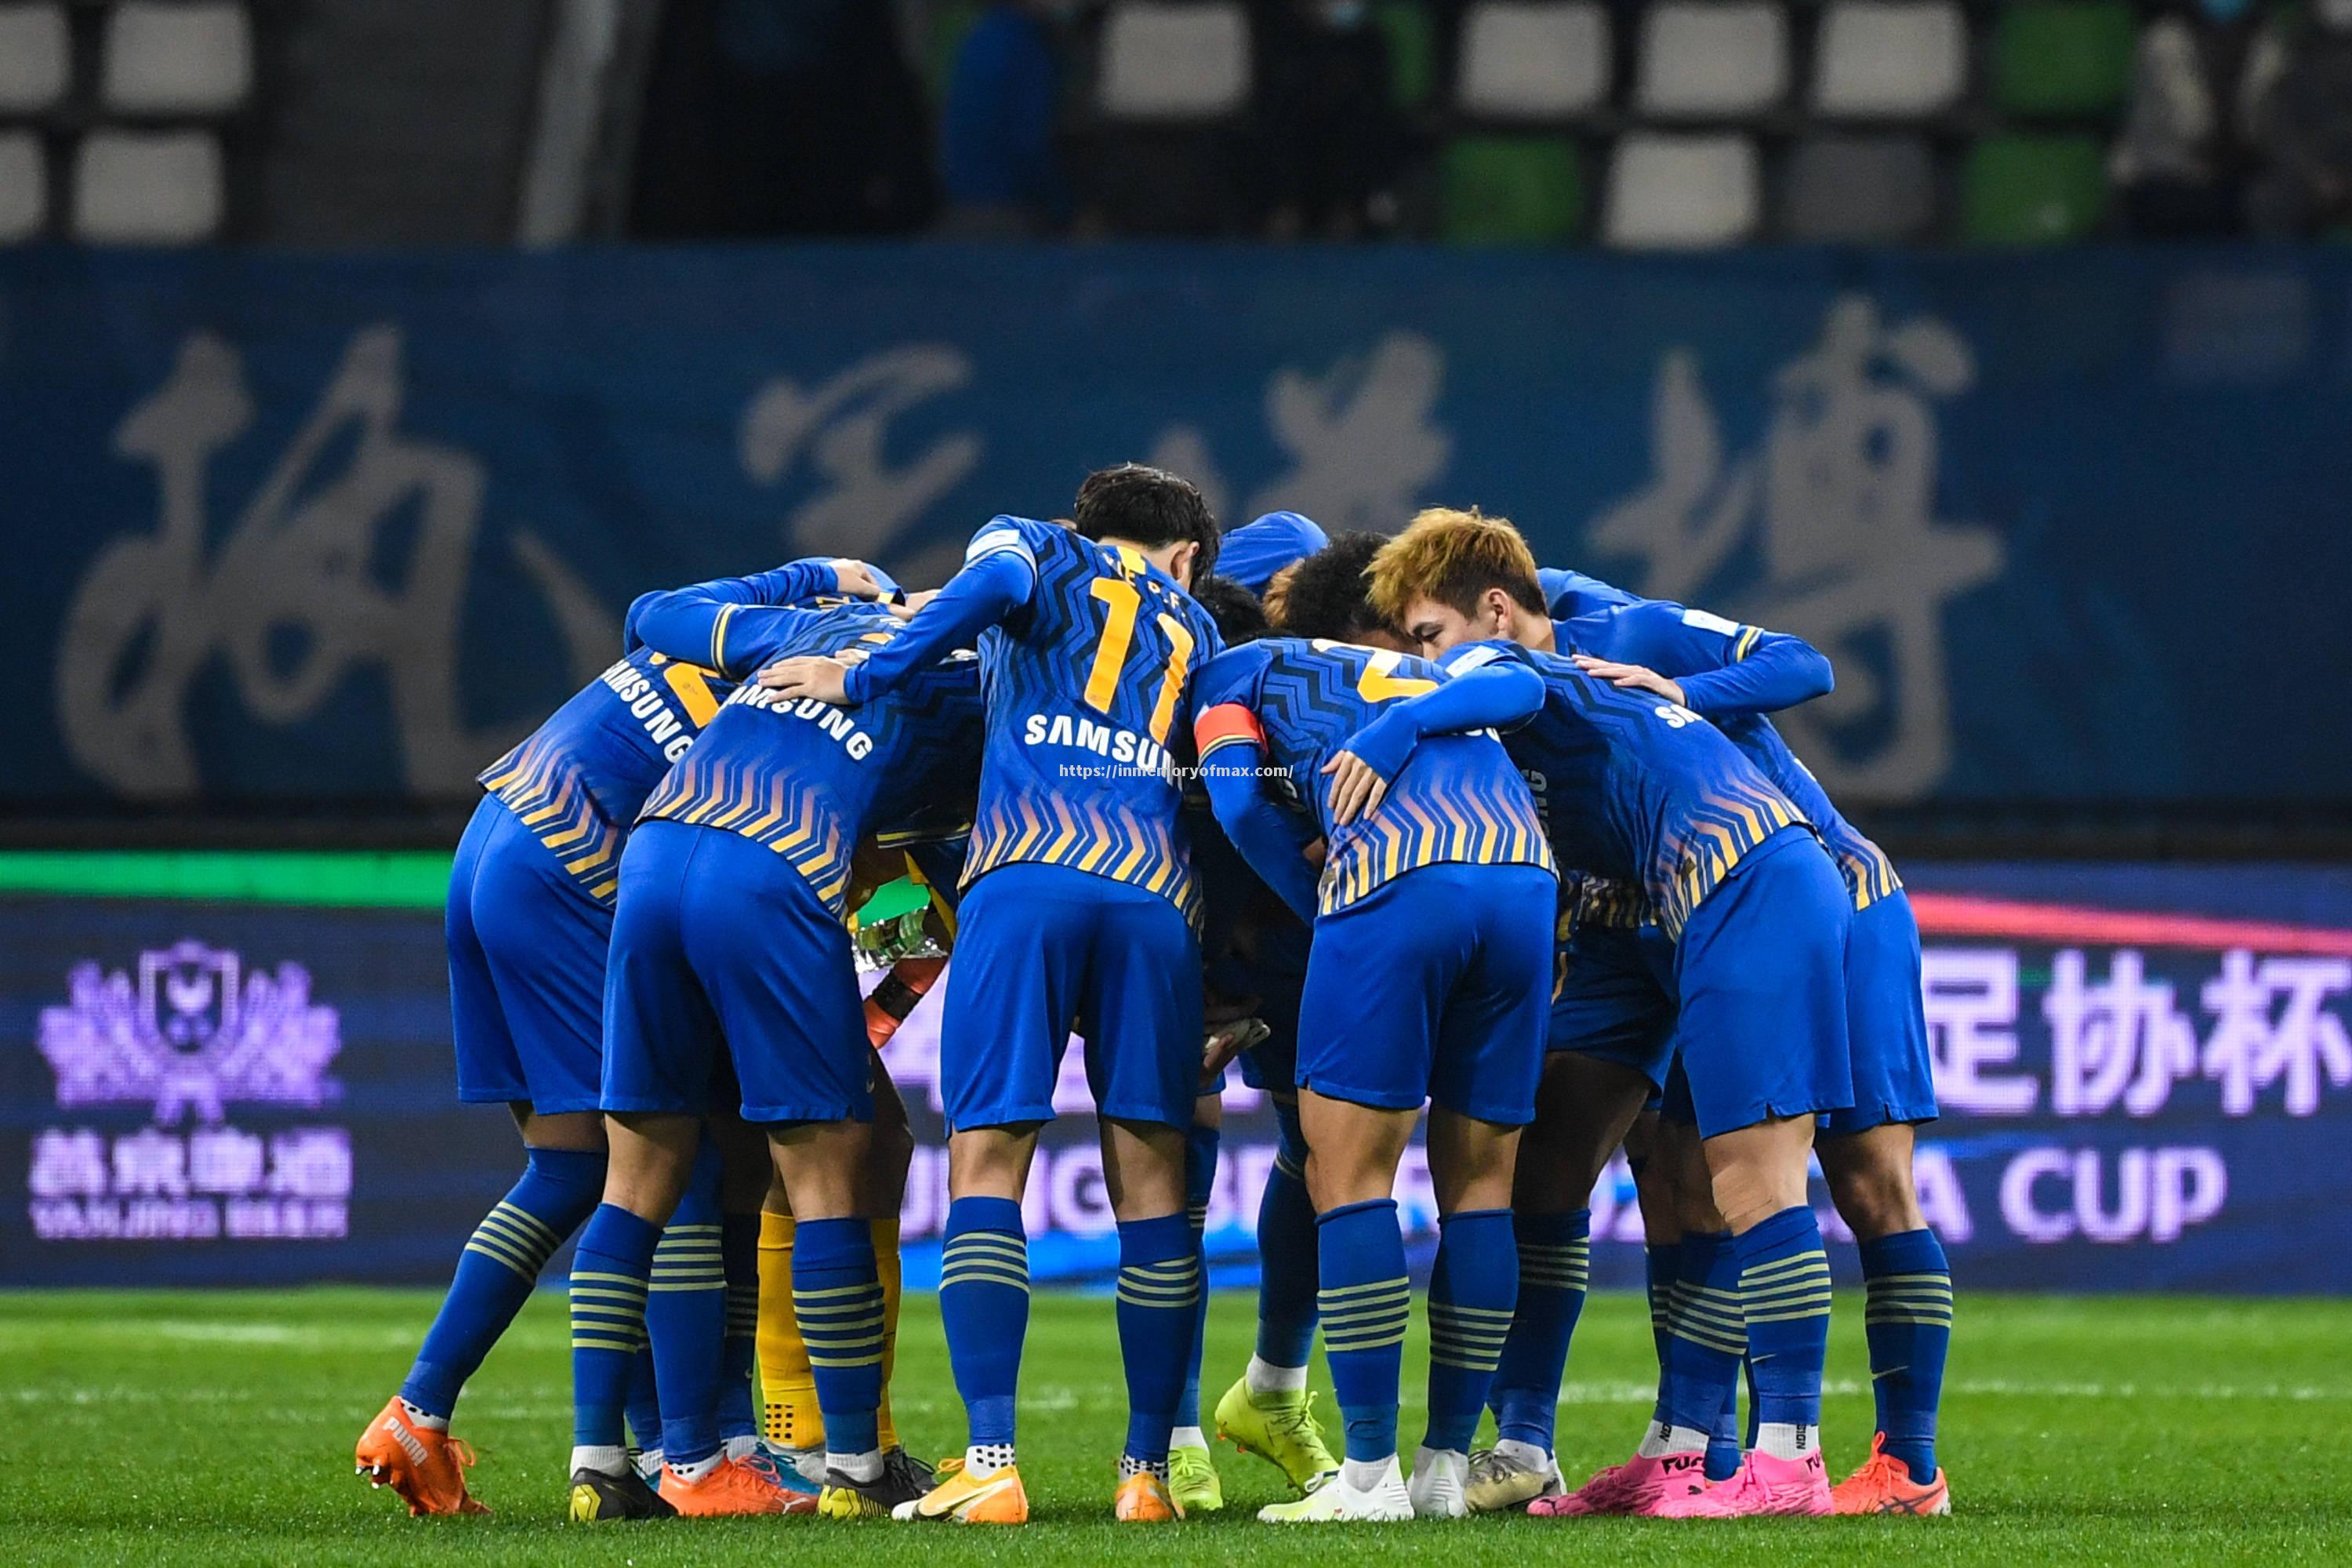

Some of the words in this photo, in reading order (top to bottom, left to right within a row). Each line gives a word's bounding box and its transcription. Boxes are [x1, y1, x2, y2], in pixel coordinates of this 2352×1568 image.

[1083, 577, 1194, 746] 11
[1920, 947, 2352, 1117] 足协杯
[1999, 1145, 2228, 1243] CUP
